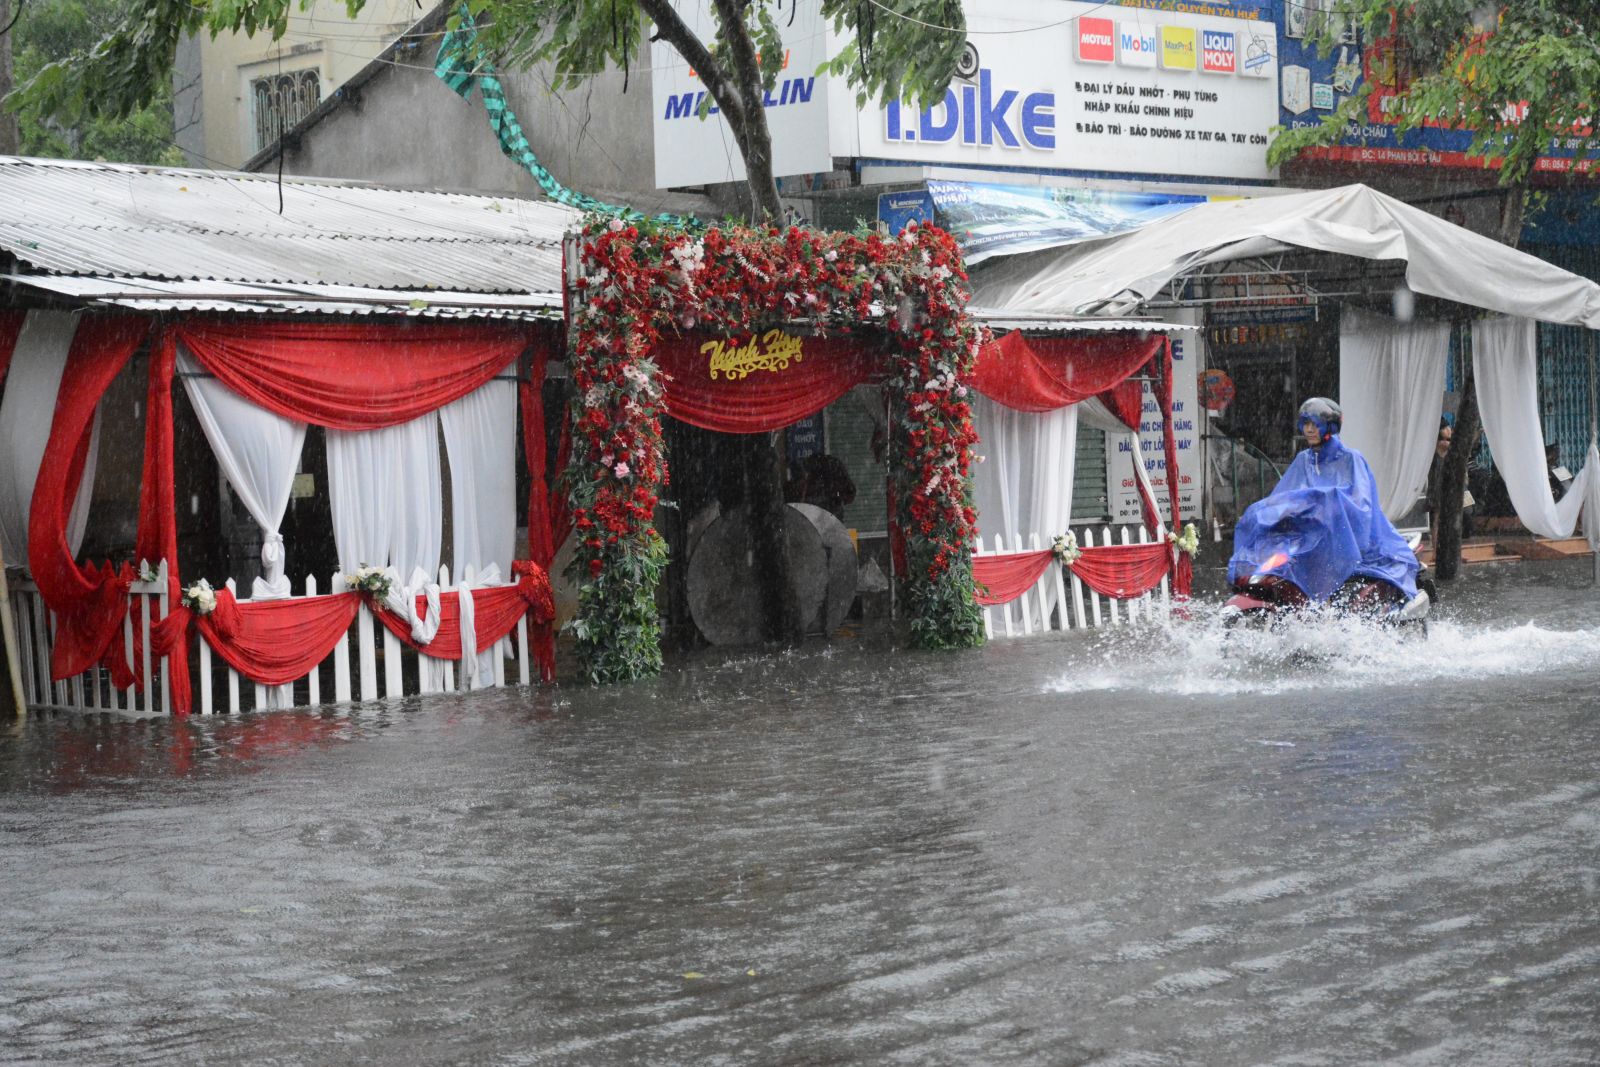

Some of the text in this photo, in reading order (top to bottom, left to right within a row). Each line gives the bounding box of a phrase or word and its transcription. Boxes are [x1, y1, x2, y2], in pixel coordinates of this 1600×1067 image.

[1081, 33, 1112, 46] MOTUL
[1121, 34, 1155, 53] Mobil
[1203, 35, 1233, 50] LIQUI
[1203, 51, 1233, 67] MOLY
[664, 77, 815, 120] MILIN
[1103, 81, 1113, 95] LÝ
[1173, 89, 1190, 103] PHỤ
[1184, 129, 1195, 140] XE
[1198, 130, 1212, 141] TAY
[1214, 131, 1226, 142] GA
[1231, 133, 1246, 143] TAY
